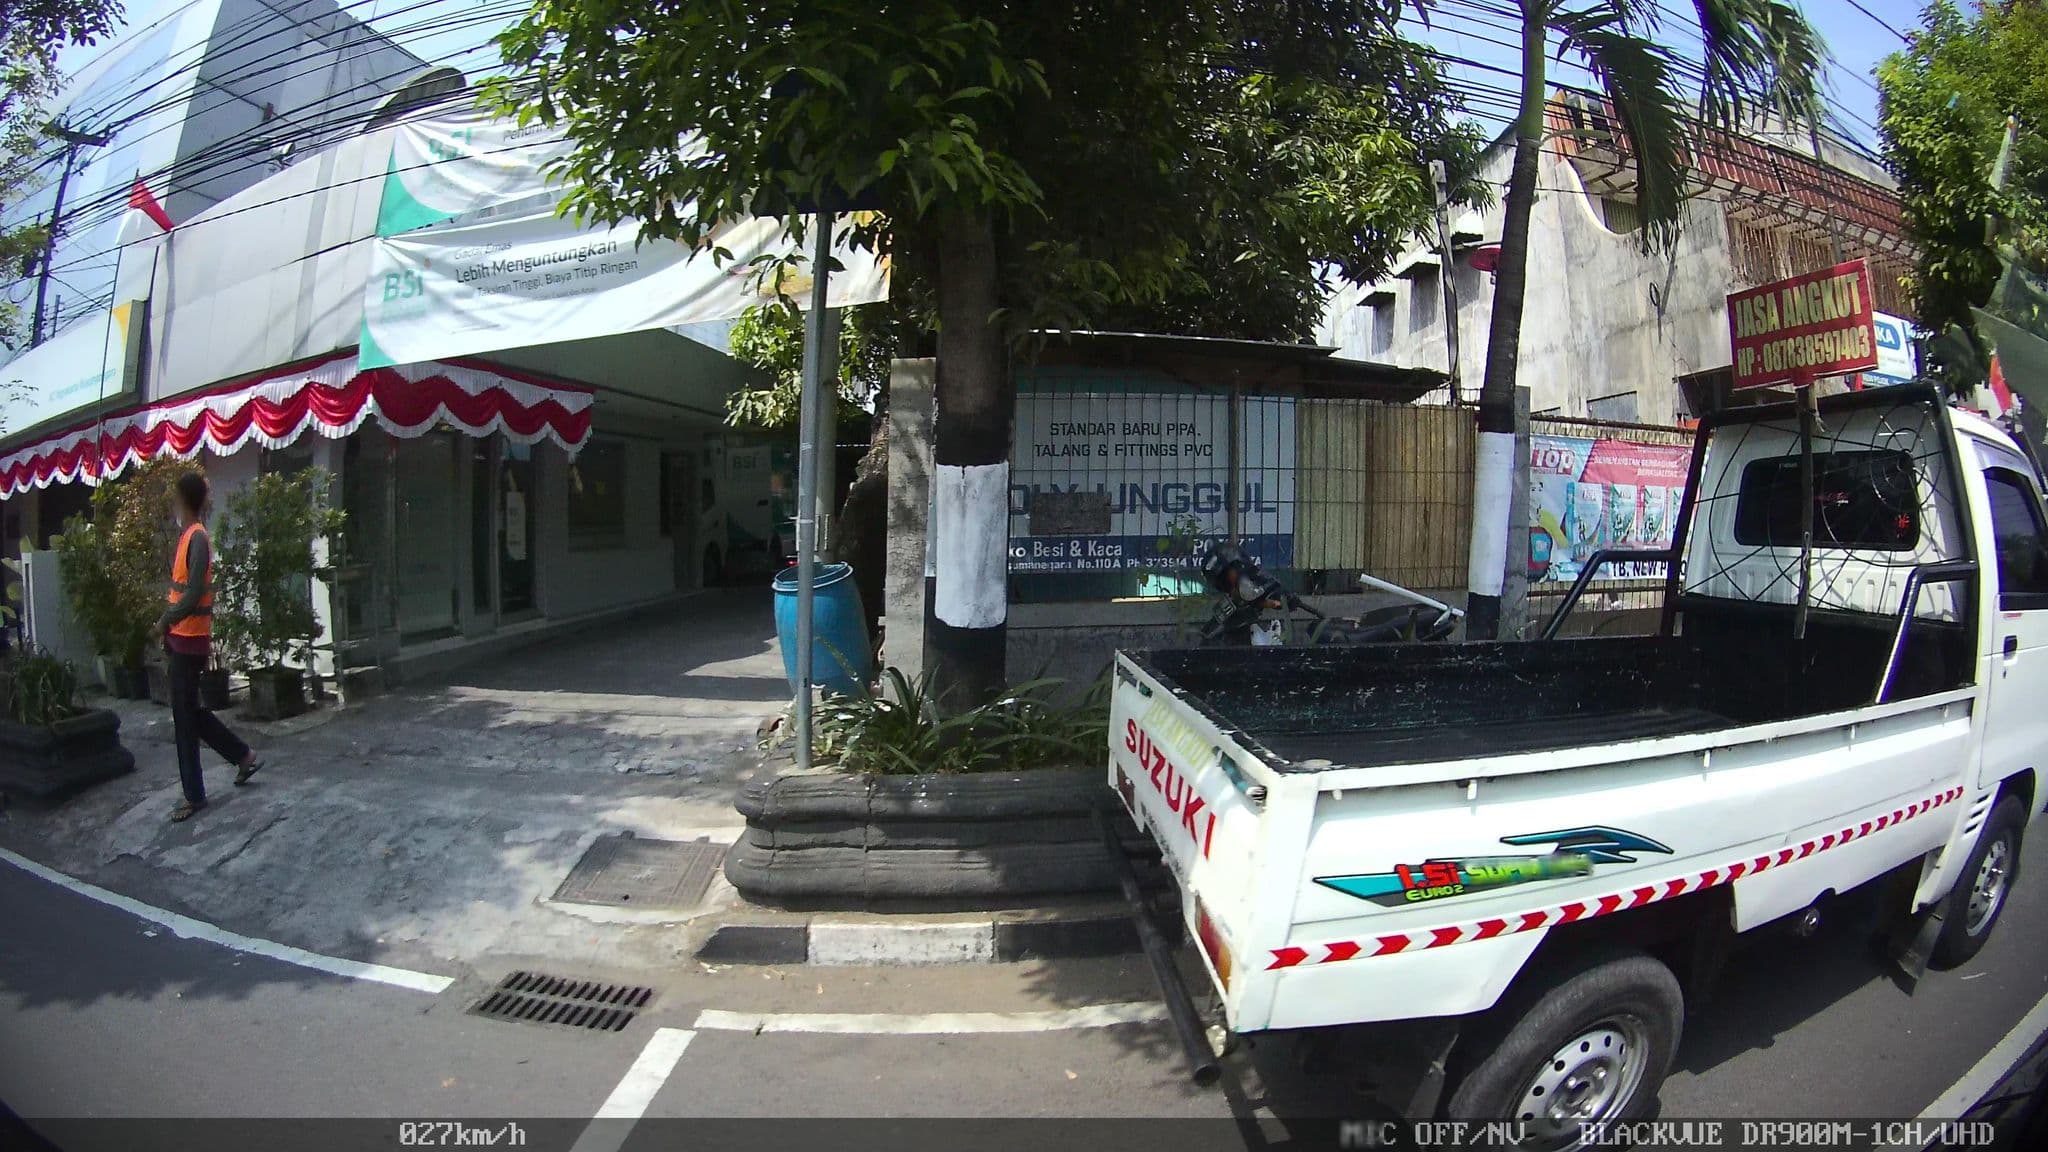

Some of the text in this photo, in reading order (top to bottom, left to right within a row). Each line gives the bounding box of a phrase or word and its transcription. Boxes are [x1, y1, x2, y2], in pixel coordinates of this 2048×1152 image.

[456, 241, 617, 283] Lebih Menguntungkan
[478, 260, 638, 297] Taksiran Tinggi, Biaya Titip Ringan
[1736, 272, 1862, 338] JASA ANGKUT
[1763, 325, 1871, 373] 087838597403
[1050, 423, 1201, 436] STANDAR BARU PIPA.
[1035, 444, 1213, 457] TALANG & FITTINGS PVC
[1531, 443, 1575, 475] Top
[1033, 541, 1064, 557] Besi
[1070, 540, 1082, 557] &
[1088, 540, 1122, 557] Kaca
[1633, 560, 1657, 577] NEW
[1125, 718, 1216, 861] SUZUKI
